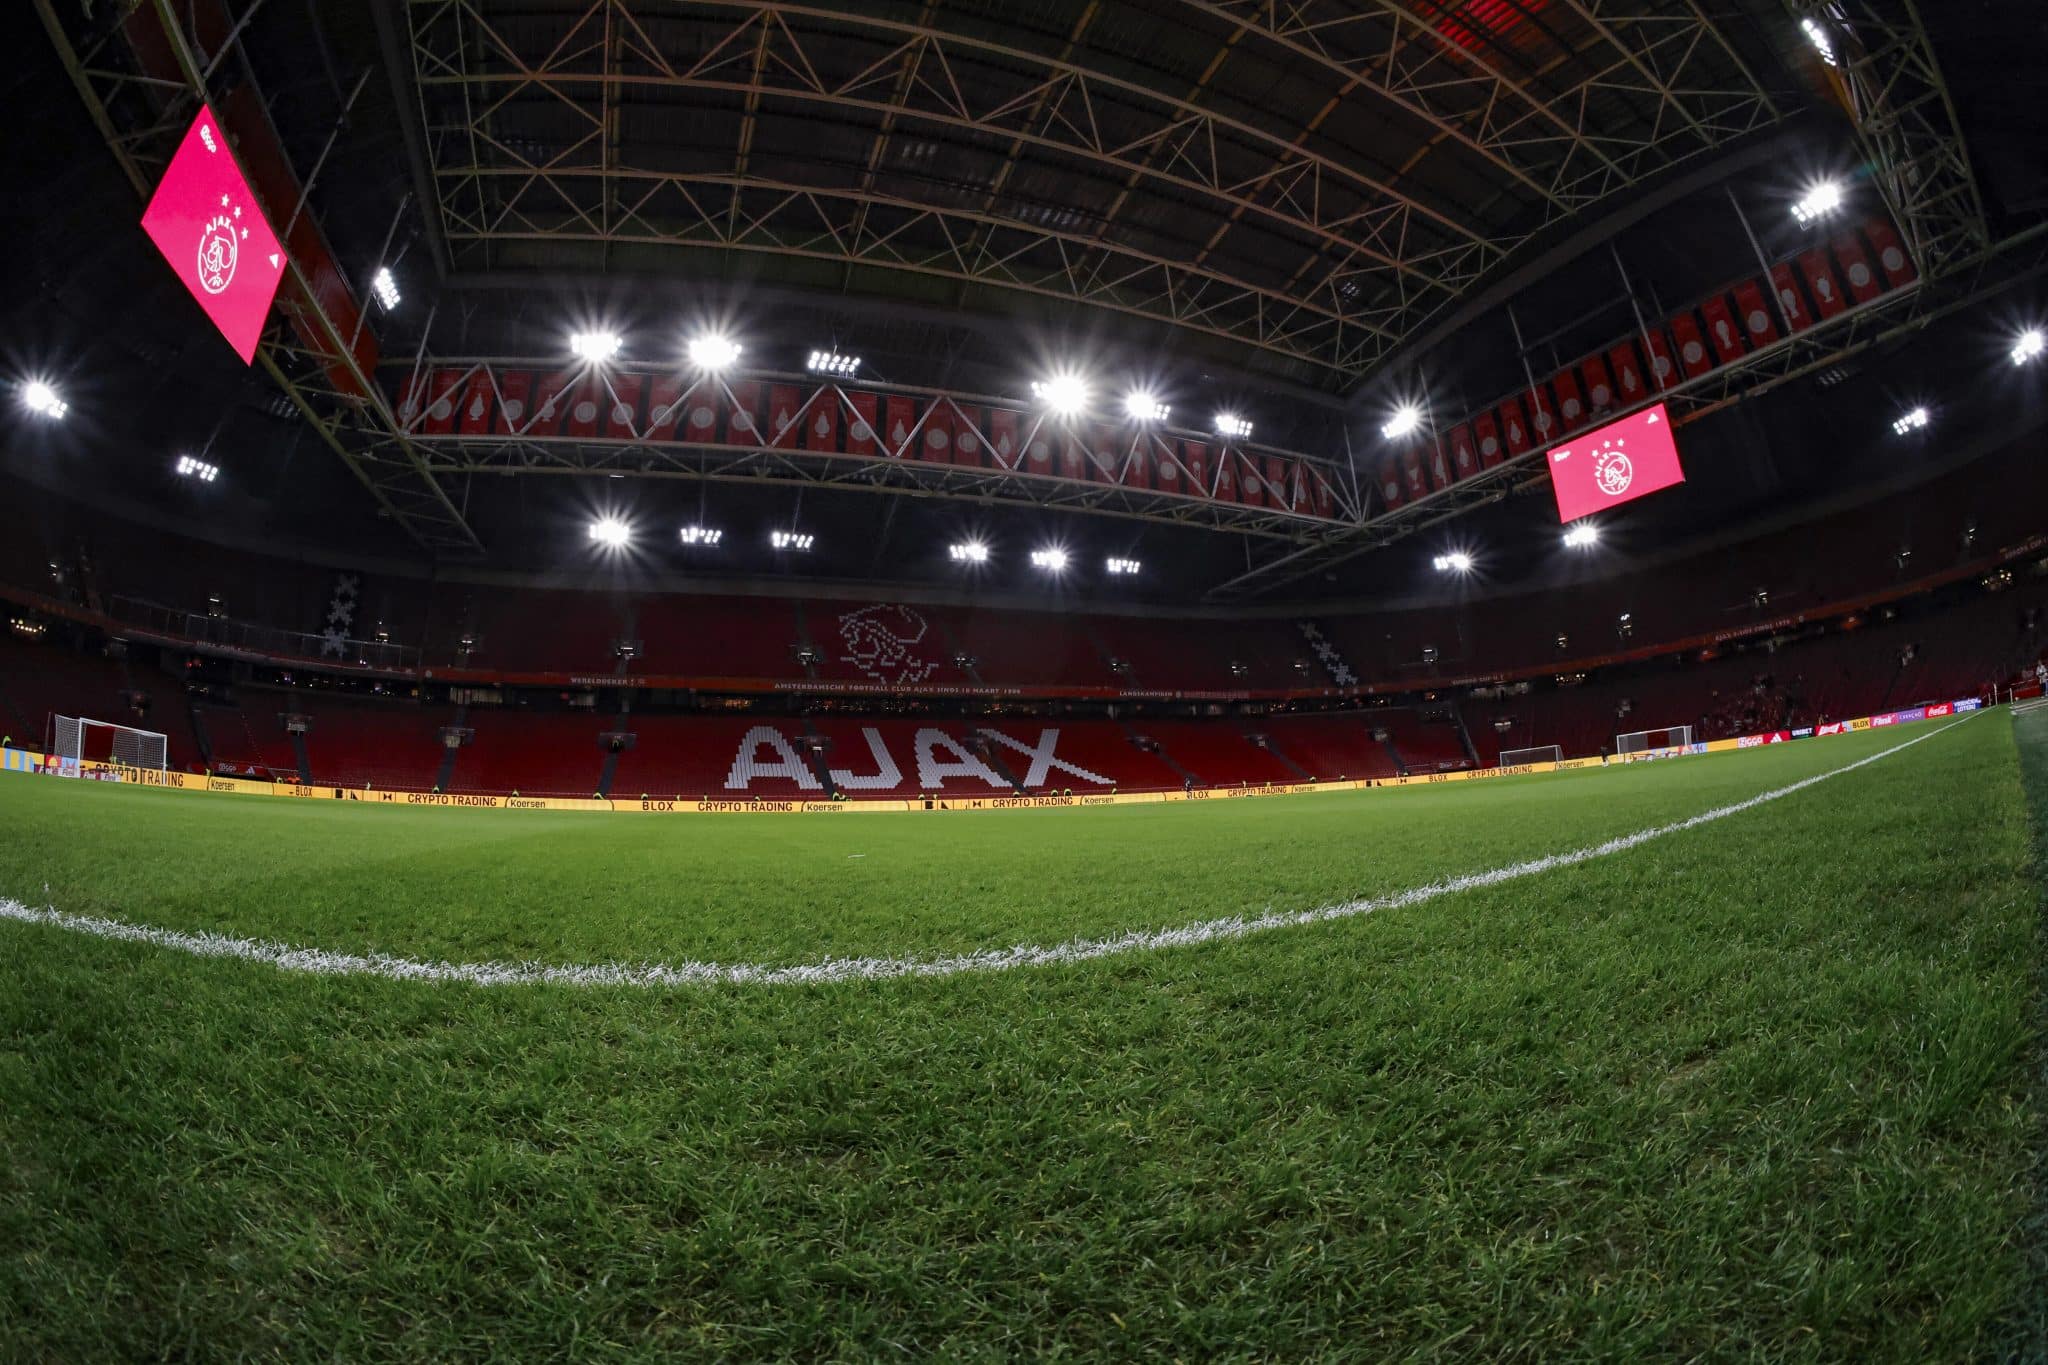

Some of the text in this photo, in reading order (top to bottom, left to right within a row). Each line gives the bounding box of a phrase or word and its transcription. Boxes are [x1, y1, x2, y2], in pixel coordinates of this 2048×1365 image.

[206, 216, 232, 236] AJAX
[849, 684, 889, 692] FOOTBALL
[1852, 719, 1869, 729] BLOX
[725, 727, 1117, 790] AJAX
[1466, 765, 1533, 779] CRYPTO TRADING
[1428, 775, 1448, 783] BLOX
[211, 780, 235, 791] Koersen
[295, 787, 313, 798] BLOX
[1227, 786, 1287, 797] CRYPTO TRADING
[408, 793, 497, 807] CRYPTO TRADING
[510, 799, 546, 809] Koersen
[992, 796, 1073, 808] CRYPTO TRADING
[1085, 796, 1114, 805] Koersen
[642, 801, 674, 811] BLOX
[698, 802, 793, 812] CRYPTO TRADING
[807, 802, 843, 812] Koersen
